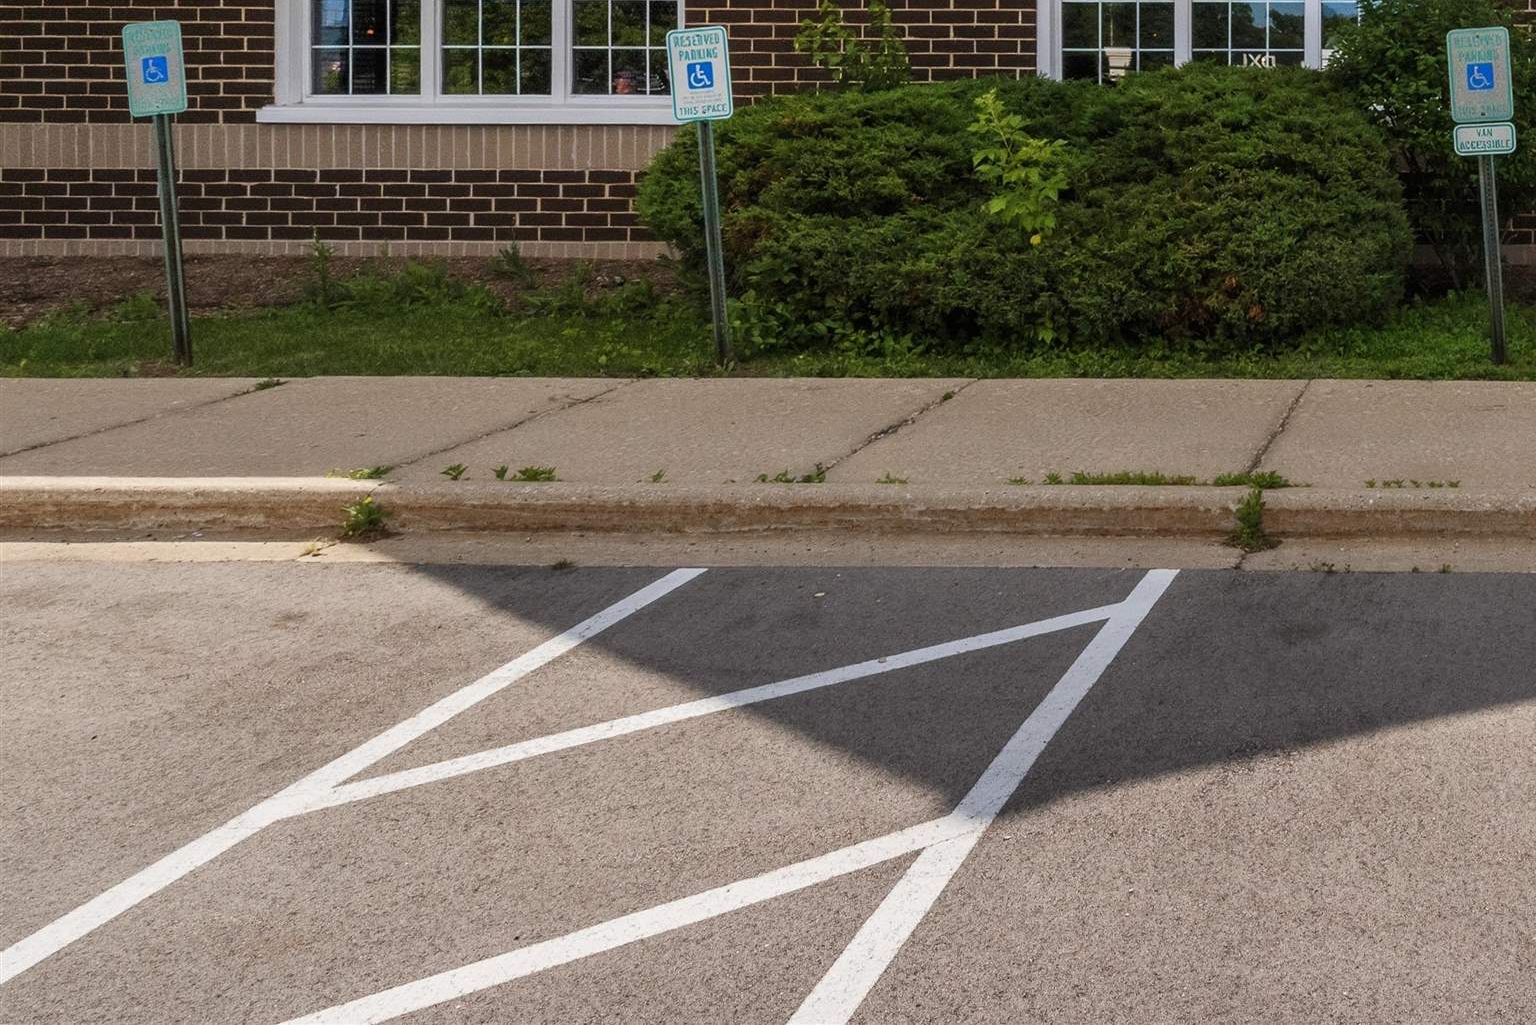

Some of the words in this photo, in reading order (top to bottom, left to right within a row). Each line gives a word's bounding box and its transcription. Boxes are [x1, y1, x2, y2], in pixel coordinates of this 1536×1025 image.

[673, 32, 720, 47] RESERVED
[679, 47, 718, 61] PARKING
[680, 106, 698, 116] THIS
[703, 103, 728, 114] SPACE
[1476, 128, 1493, 137] VAN
[1460, 139, 1511, 150] ACCESSIBLE
